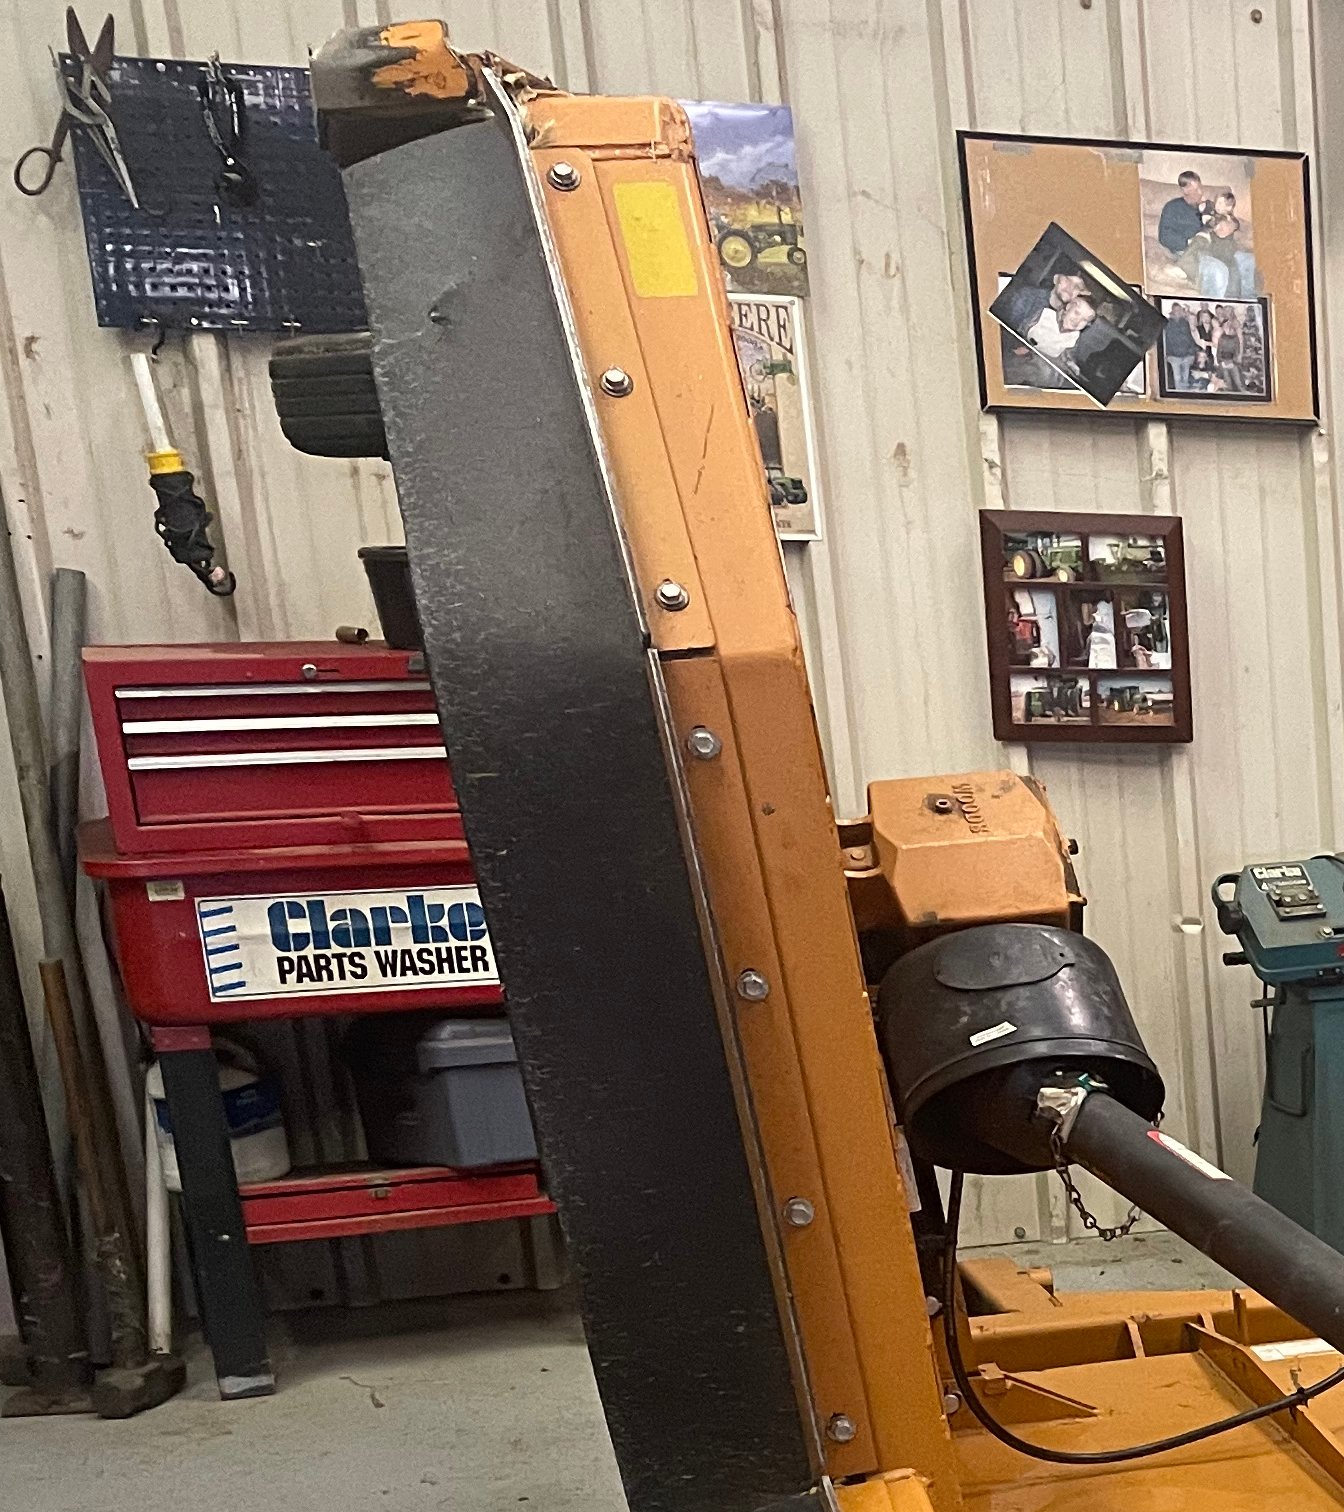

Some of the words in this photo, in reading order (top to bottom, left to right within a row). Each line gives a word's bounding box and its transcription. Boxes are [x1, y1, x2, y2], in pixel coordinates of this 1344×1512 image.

[267, 894, 488, 953] Clarke
[276, 951, 369, 985] PARTS
[374, 945, 490, 978] WASHER
